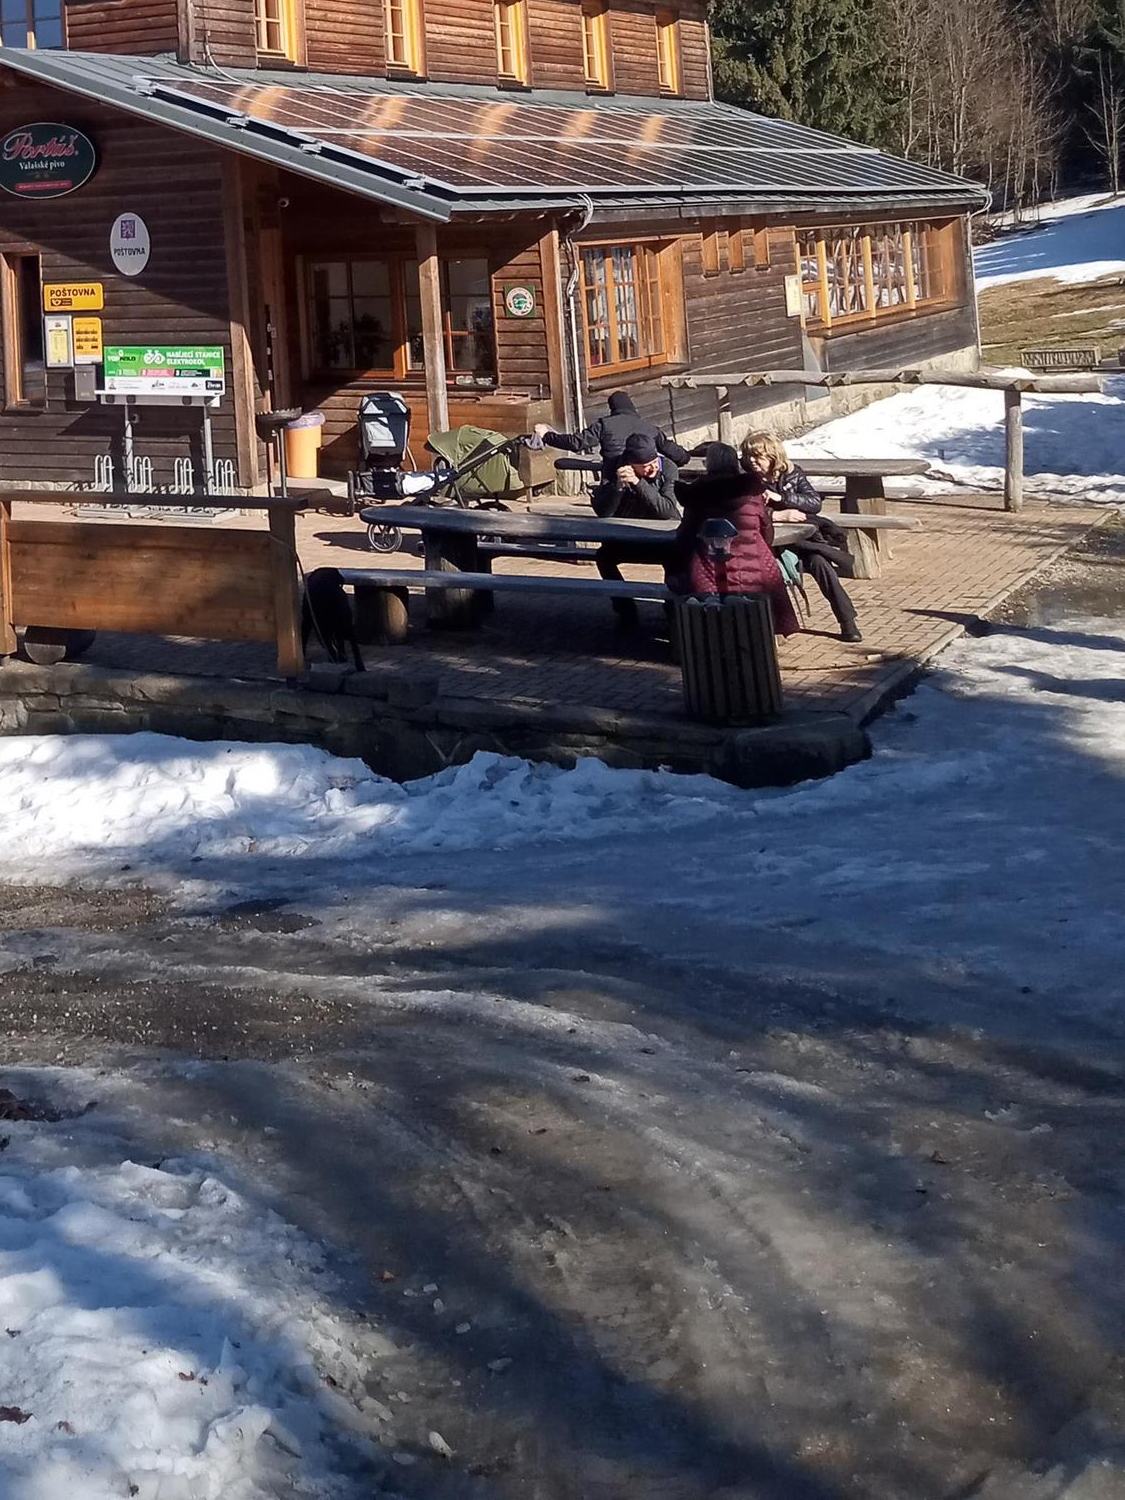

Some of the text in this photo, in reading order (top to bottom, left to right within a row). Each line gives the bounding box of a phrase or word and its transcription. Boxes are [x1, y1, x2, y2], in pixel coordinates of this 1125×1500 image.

[49, 160, 66, 171] pivo
[113, 246, 146, 257] POŠTOVNA
[49, 288, 96, 298] POŠTOVNA
